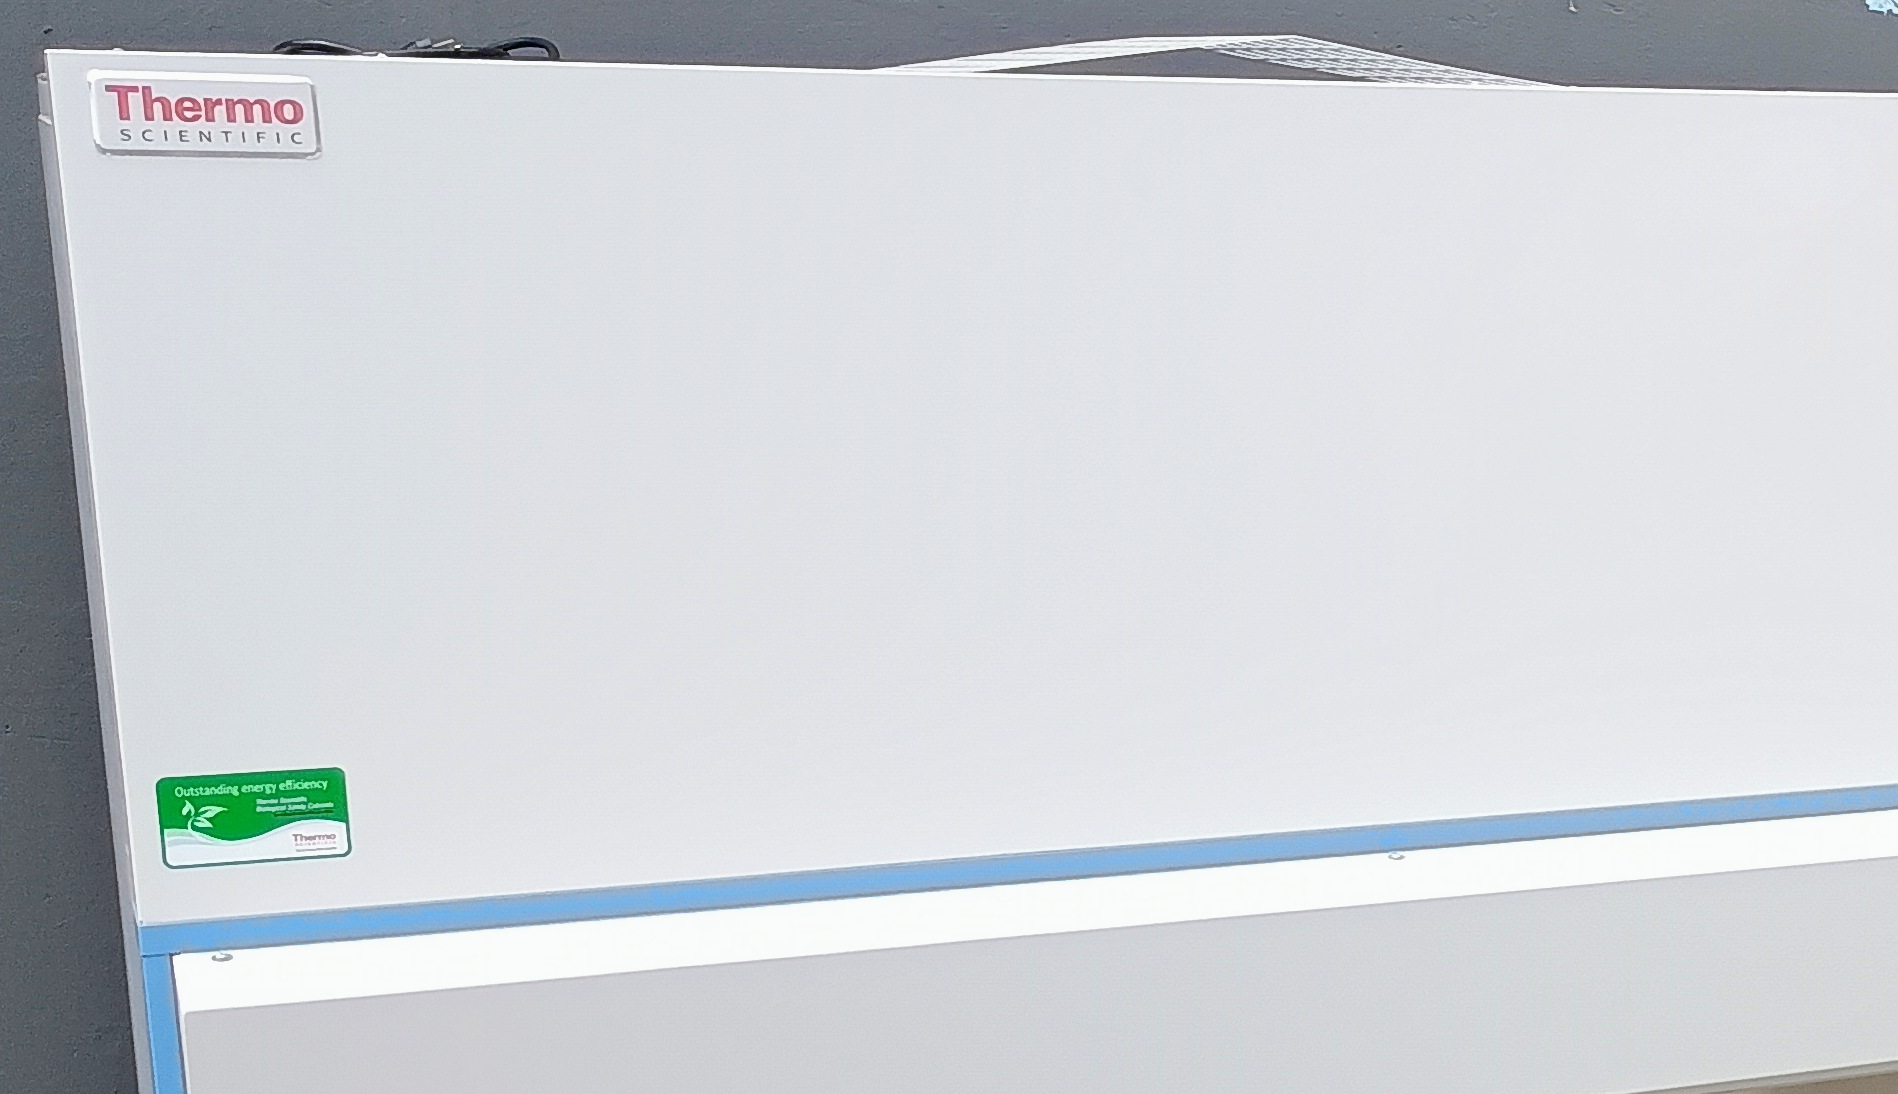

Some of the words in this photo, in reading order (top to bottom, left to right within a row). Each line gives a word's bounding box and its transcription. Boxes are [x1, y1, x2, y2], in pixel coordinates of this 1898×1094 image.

[105, 84, 304, 125] Thermo
[120, 128, 303, 145] SCIENTIFIC
[174, 784, 240, 797] Outstanding
[241, 782, 277, 794] energy
[279, 779, 328, 791] efficiency
[292, 833, 337, 843] Thermo
